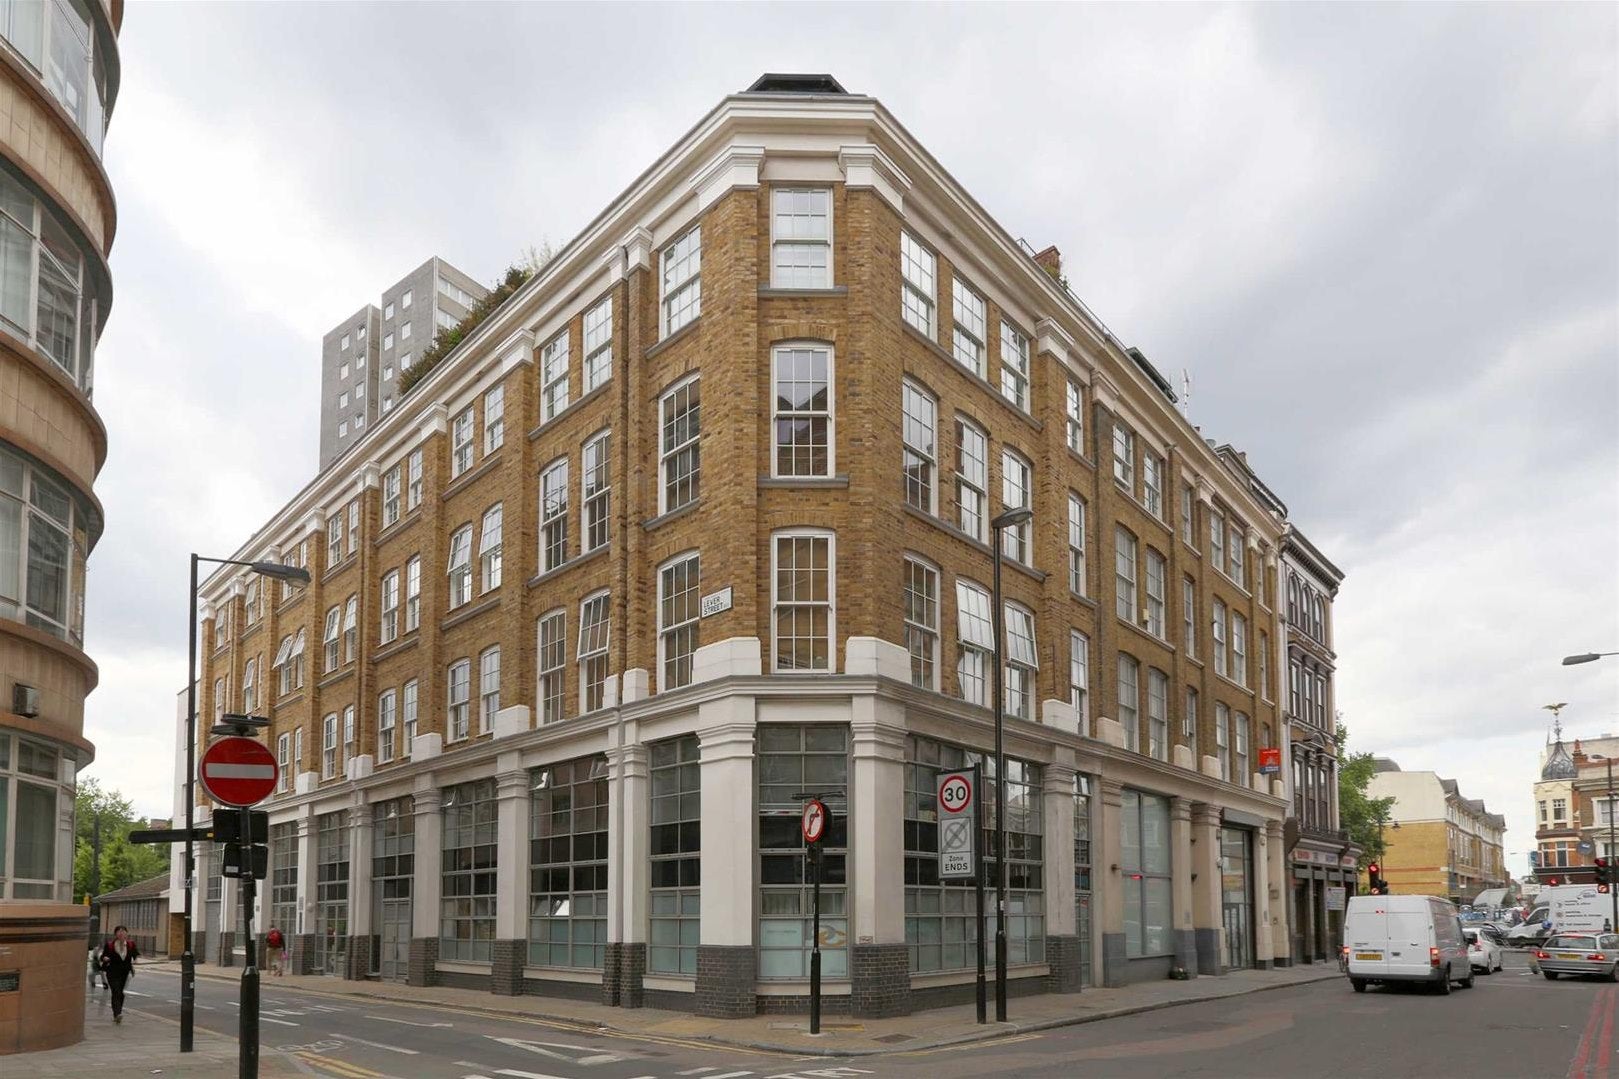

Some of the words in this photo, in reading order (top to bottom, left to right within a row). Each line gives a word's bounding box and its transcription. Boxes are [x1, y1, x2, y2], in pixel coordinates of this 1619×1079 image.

[703, 596, 720, 607] LEVER
[704, 602, 723, 615] STREET
[944, 786, 966, 802] 30
[945, 862, 968, 871] ENDS
